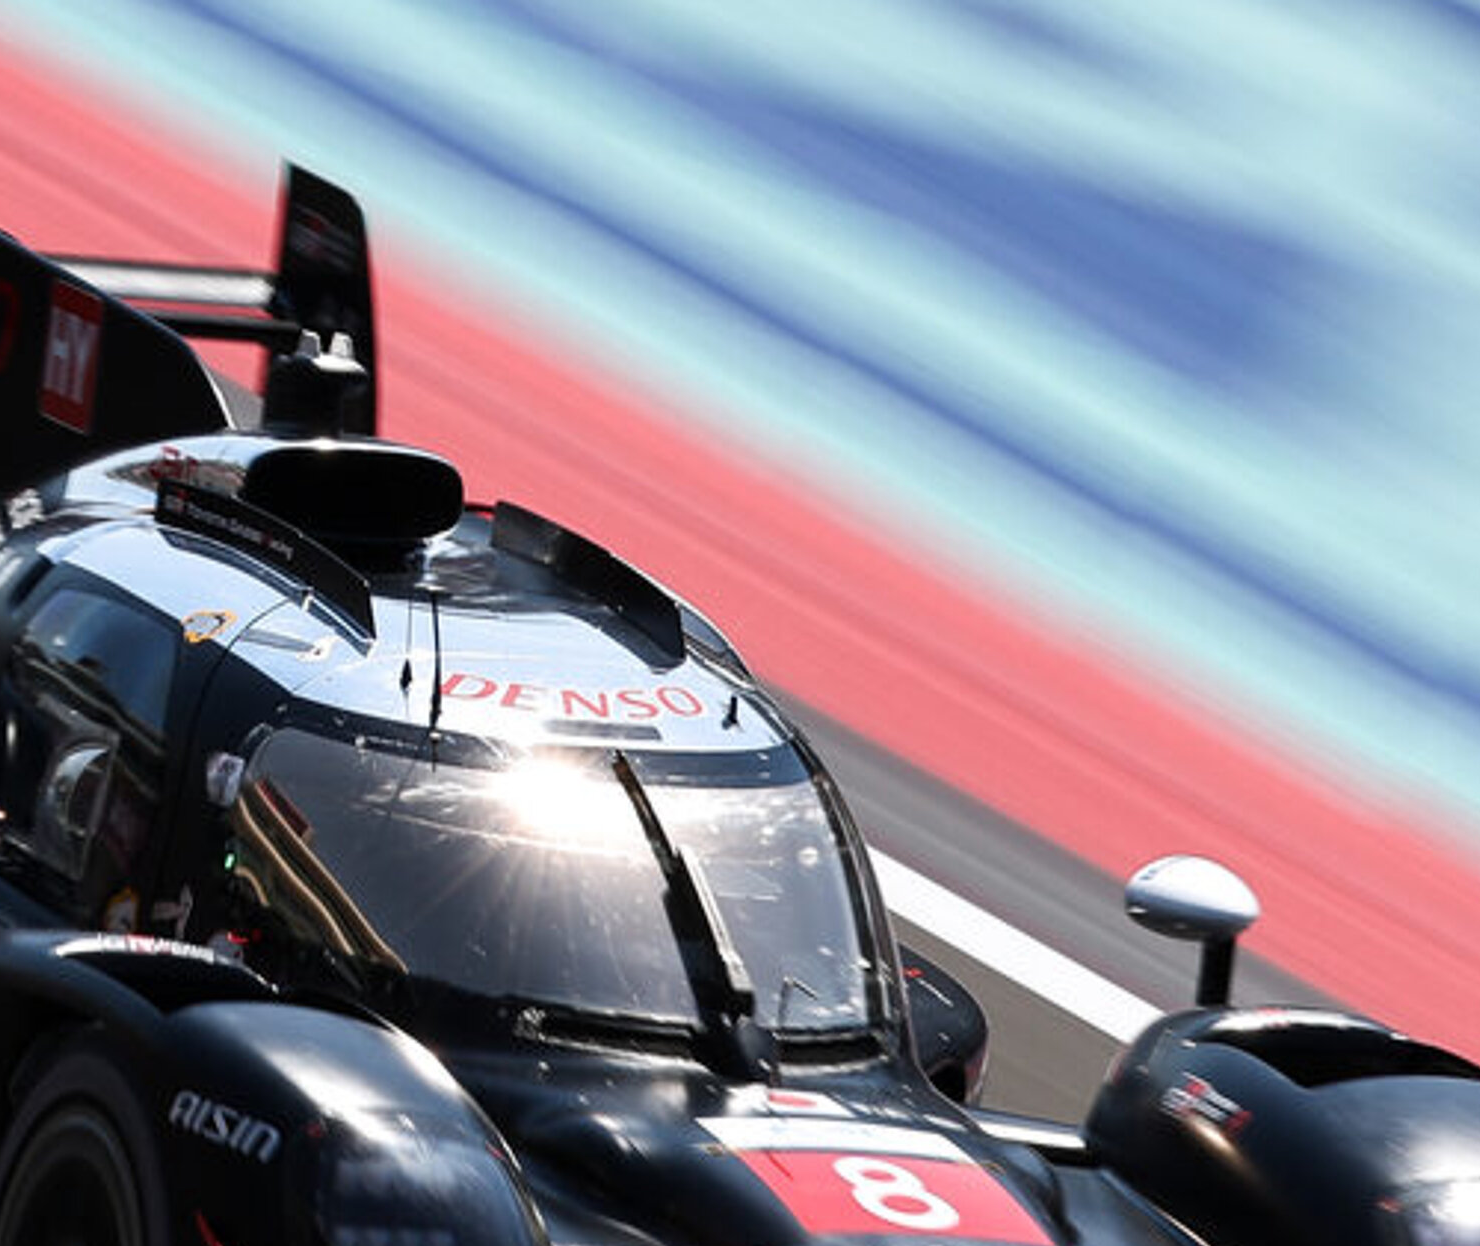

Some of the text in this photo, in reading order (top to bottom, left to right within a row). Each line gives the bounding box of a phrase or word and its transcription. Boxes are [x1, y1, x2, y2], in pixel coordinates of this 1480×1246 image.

[440, 672, 704, 719] DENSO
[169, 1090, 281, 1163] AISIN
[833, 1157, 960, 1230] 8
